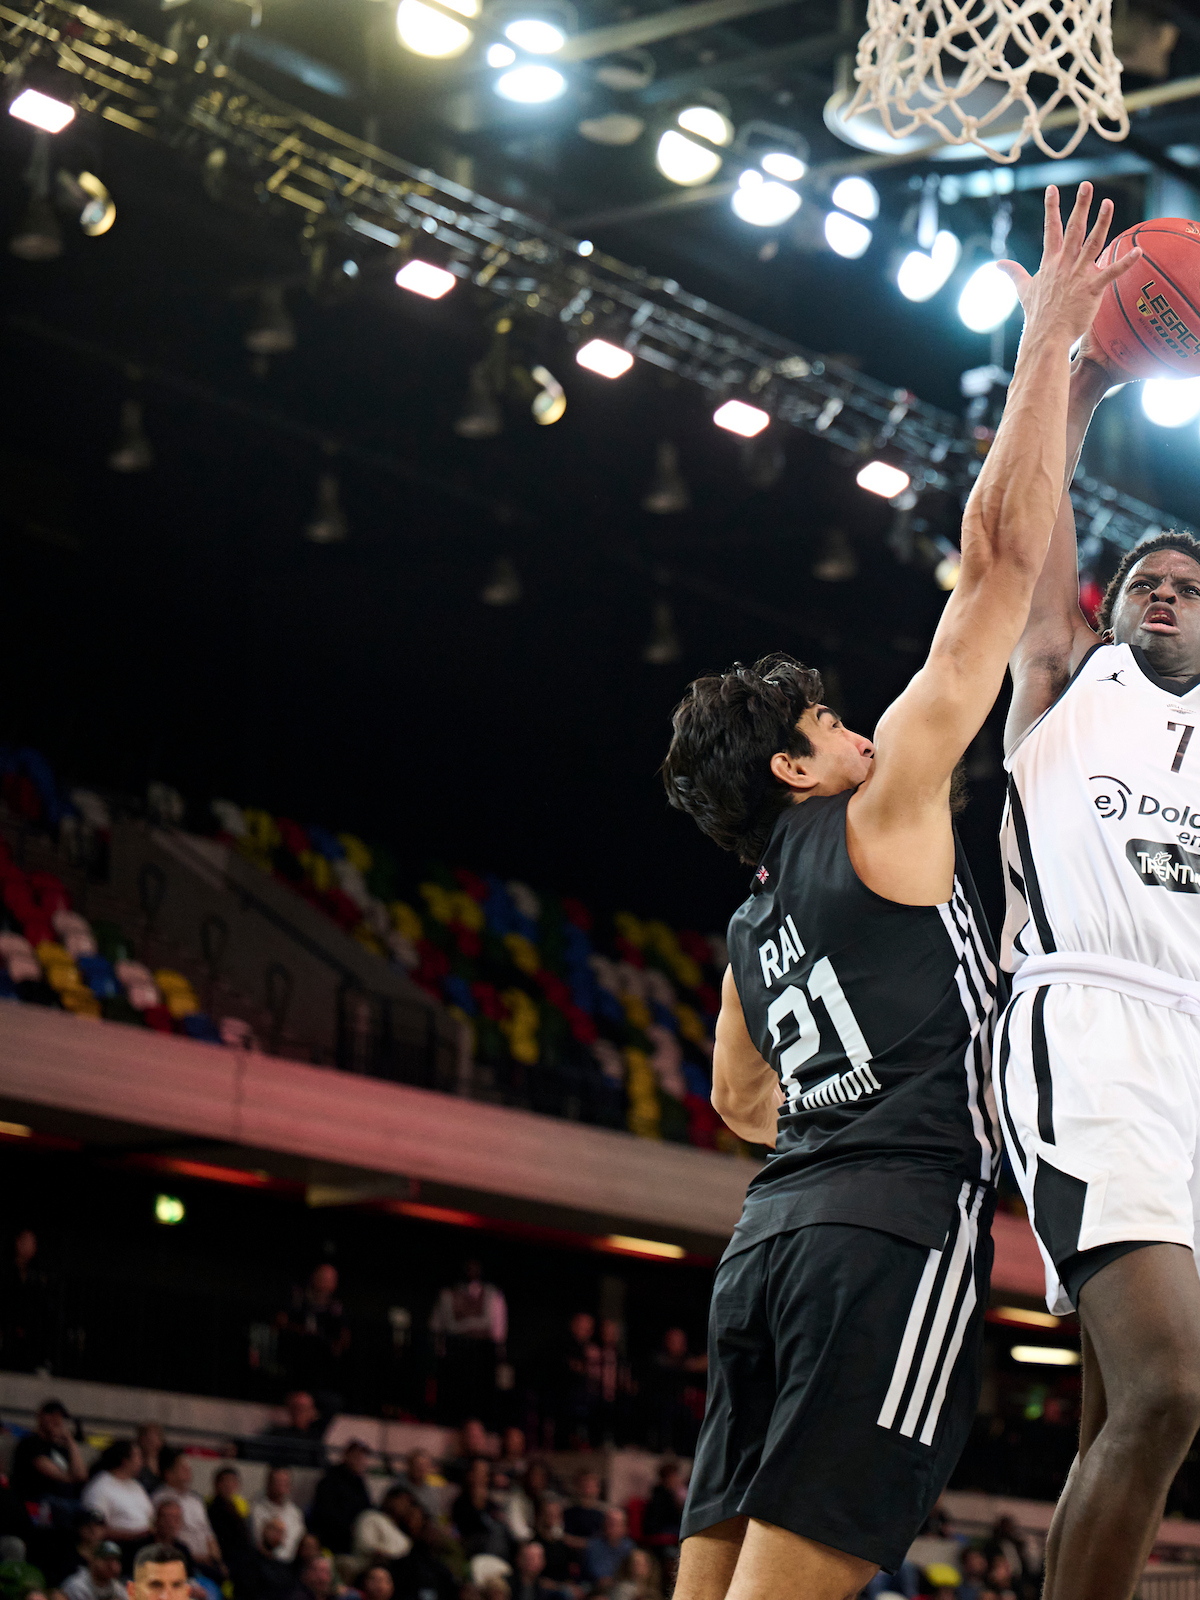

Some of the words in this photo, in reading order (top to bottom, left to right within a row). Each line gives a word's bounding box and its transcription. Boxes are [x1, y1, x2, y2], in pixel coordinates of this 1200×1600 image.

[1148, 317, 1189, 359] 1000
[1167, 720, 1195, 773] 7
[758, 914, 806, 988] RAI
[767, 955, 874, 1101] 21
